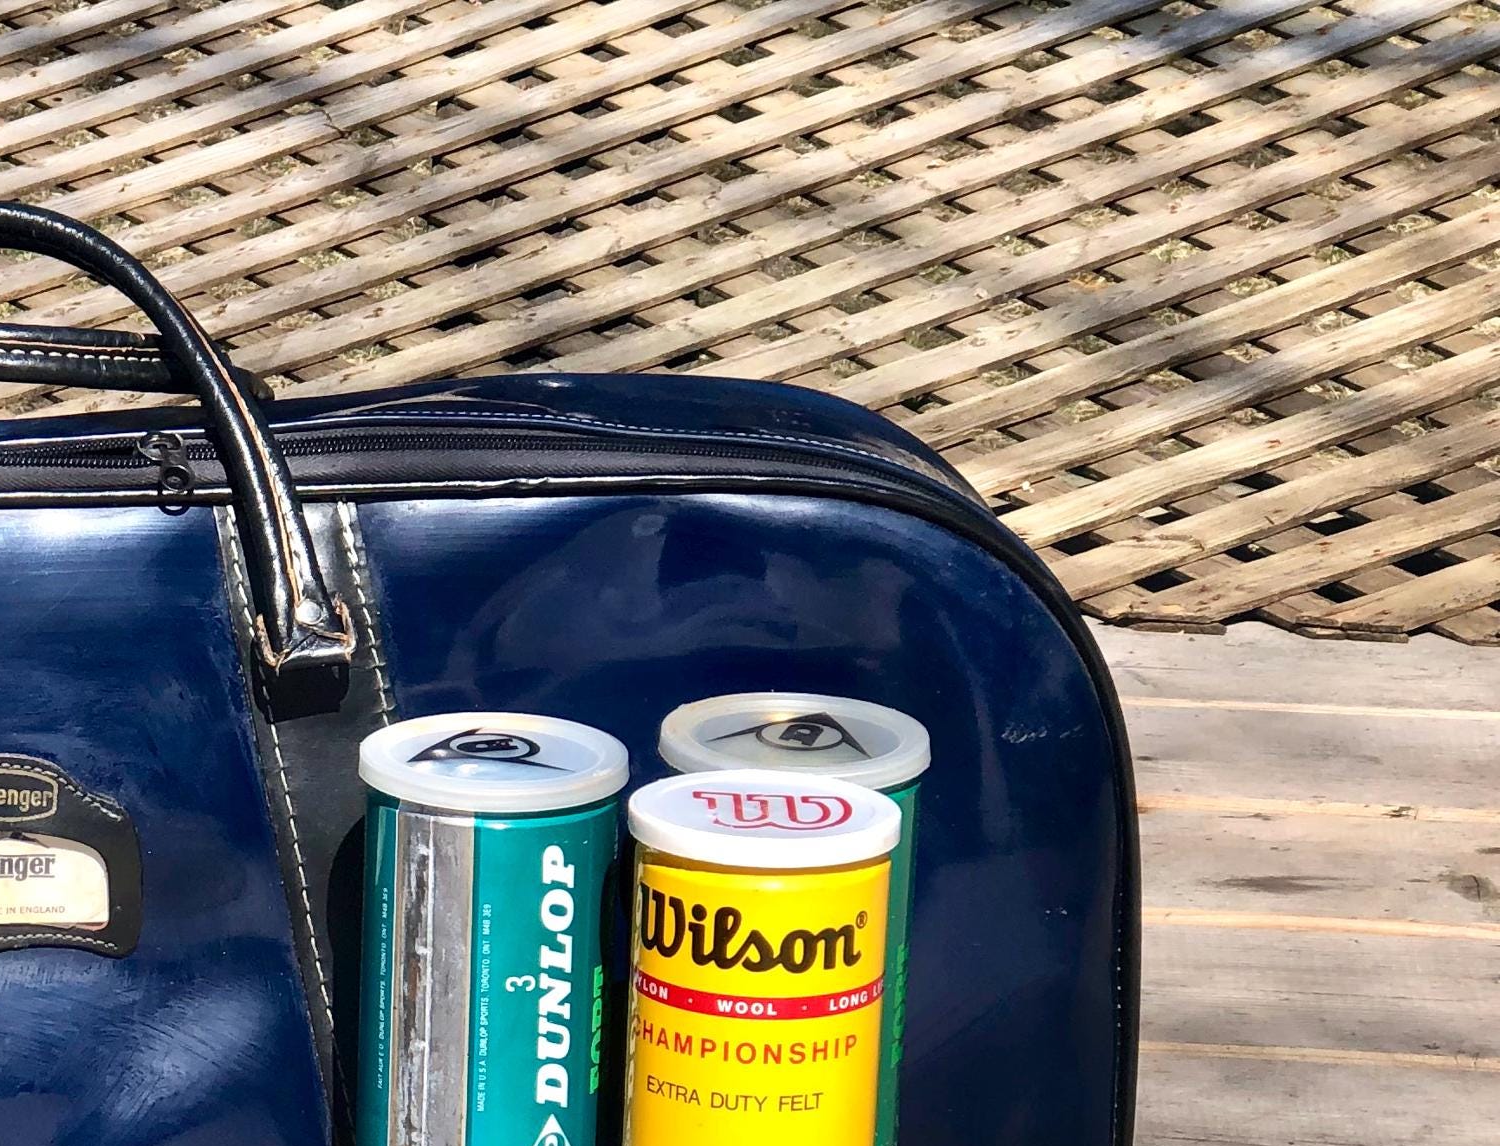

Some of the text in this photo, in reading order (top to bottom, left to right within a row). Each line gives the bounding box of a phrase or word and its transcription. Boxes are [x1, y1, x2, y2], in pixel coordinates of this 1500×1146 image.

[6, 906, 16, 915] IN
[19, 905, 65, 915] ENGLAND
[483, 903, 492, 917] 3E9
[505, 974, 536, 992] 3
[535, 844, 575, 1108] DUNLOP
[634, 969, 668, 1000] YLON
[716, 998, 778, 1017] WOOL
[829, 990, 868, 1011] LONG
[479, 1027, 488, 1056] DUNLOP
[478, 1082, 486, 1091] IN
[647, 1075, 824, 1112] EXTRA DUTY FELT
[476, 1091, 486, 1112] MADE
